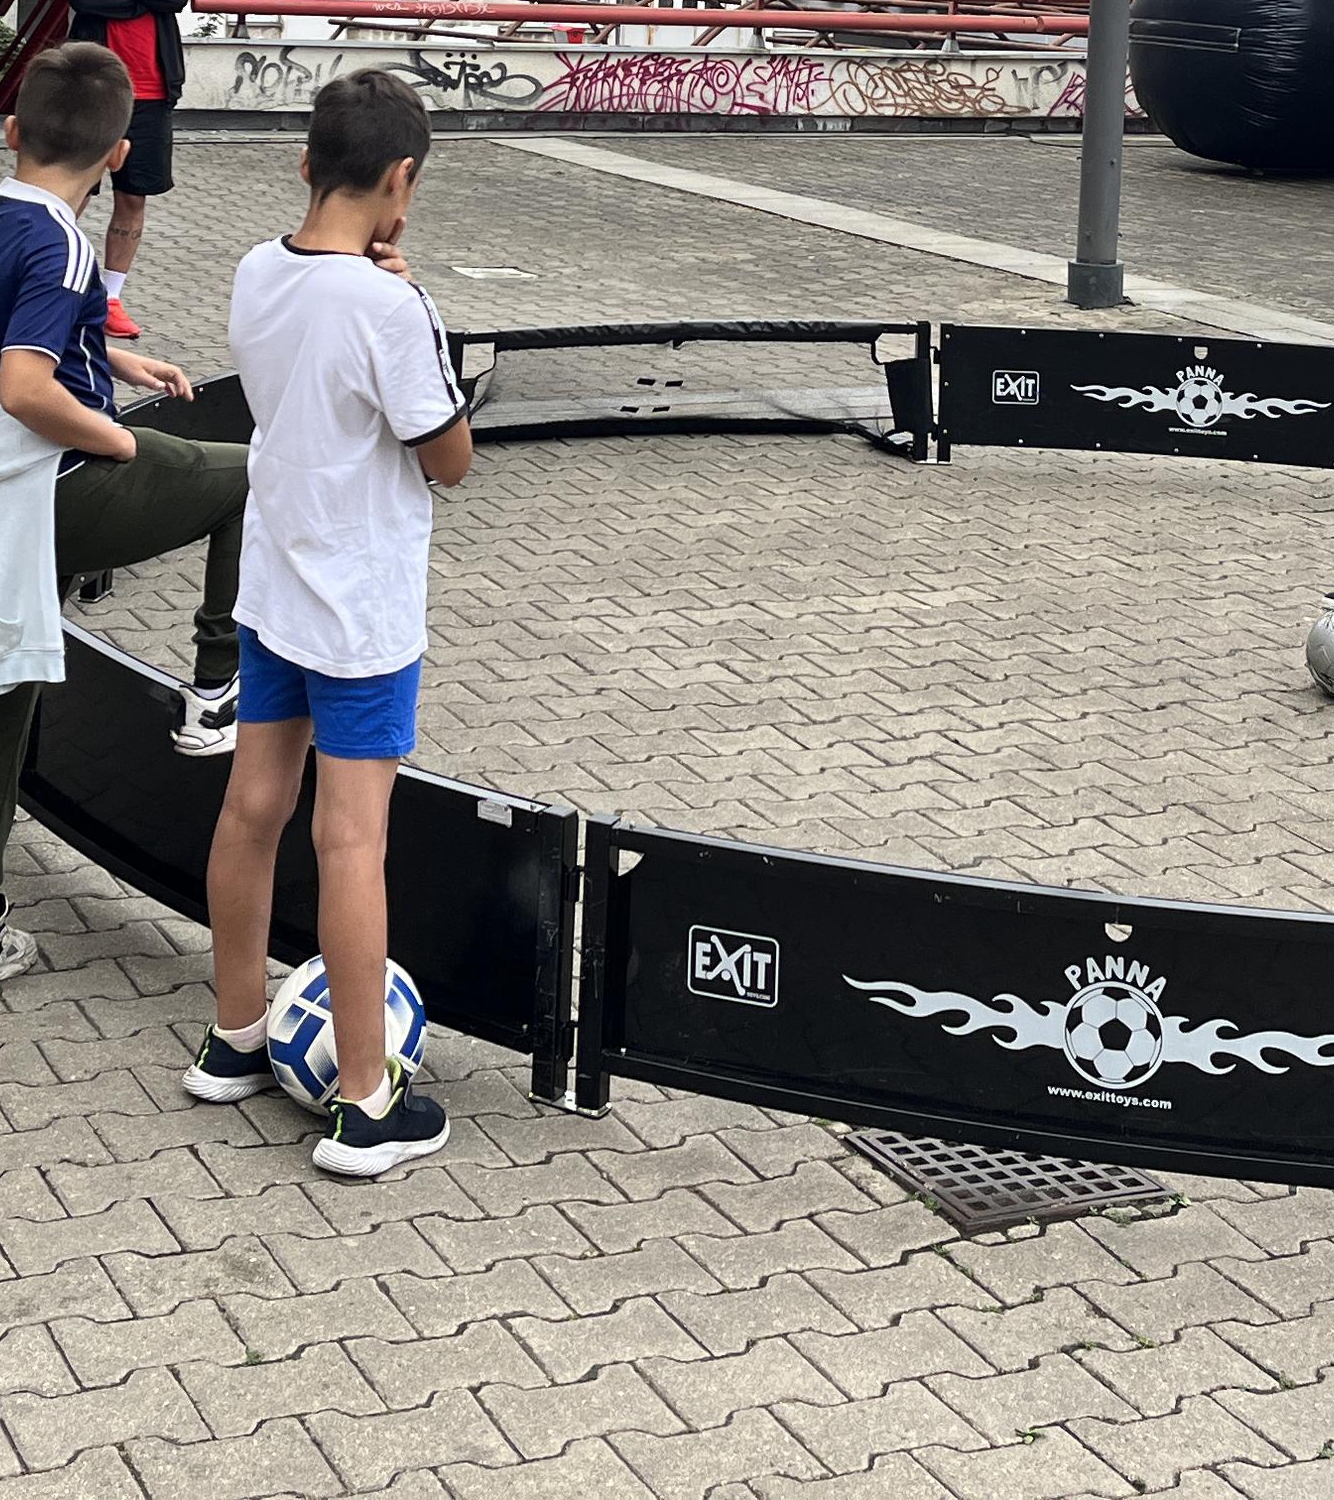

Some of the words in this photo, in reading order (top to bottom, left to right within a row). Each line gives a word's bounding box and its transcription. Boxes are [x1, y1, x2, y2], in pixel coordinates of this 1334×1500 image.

[996, 373, 1036, 401] EXIT
[1175, 365, 1224, 387] PANNA
[695, 934, 771, 996] EXIT
[1064, 955, 1167, 1003] PANNA
[1047, 1085, 1173, 1110] www.exittoys.com
